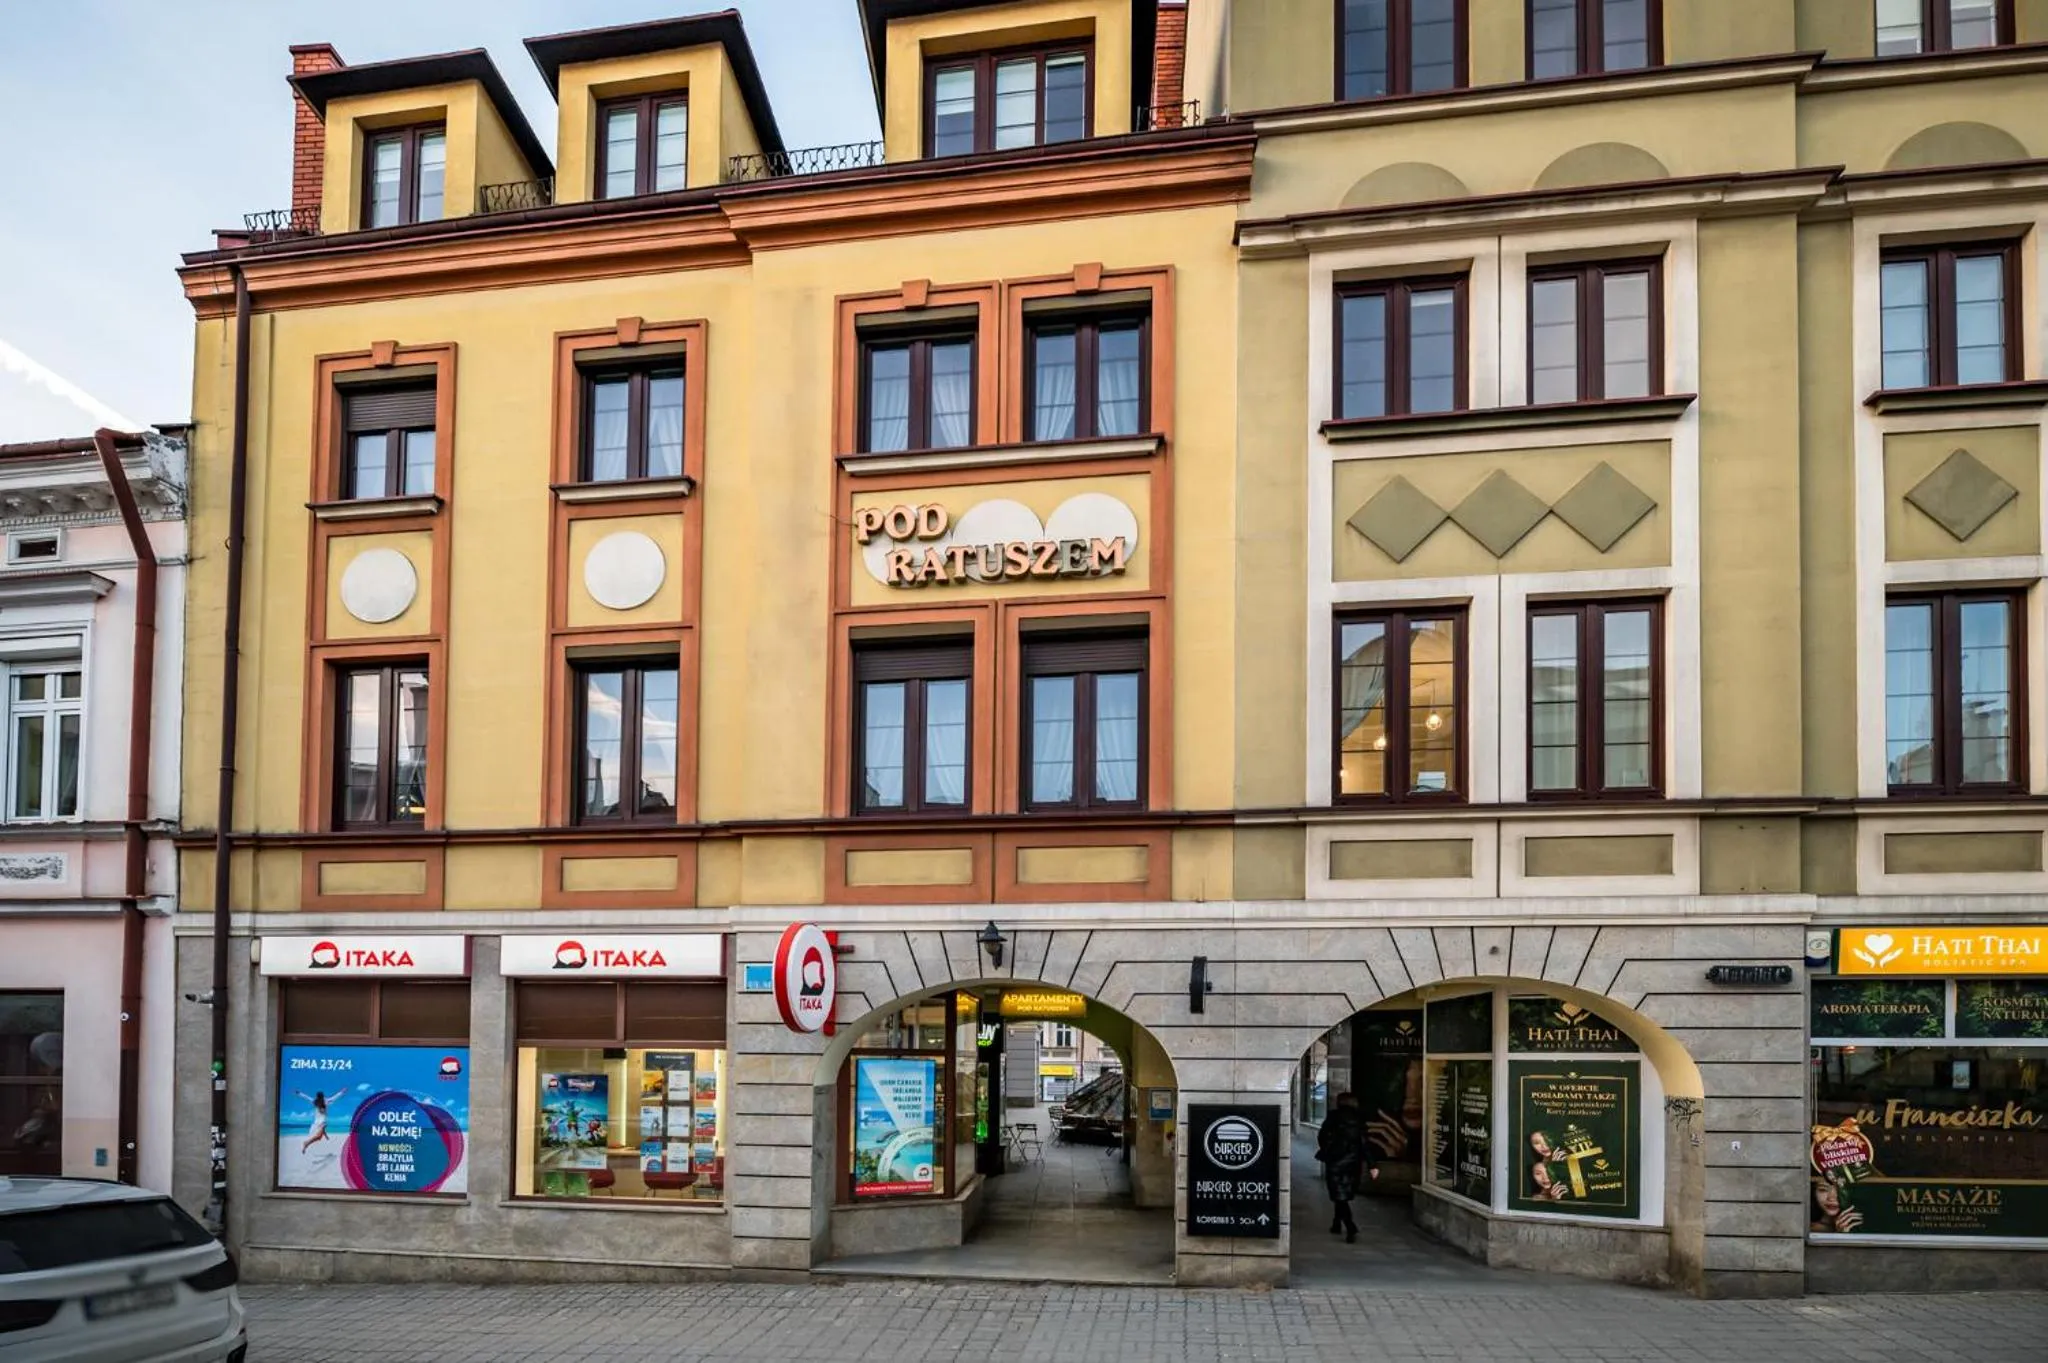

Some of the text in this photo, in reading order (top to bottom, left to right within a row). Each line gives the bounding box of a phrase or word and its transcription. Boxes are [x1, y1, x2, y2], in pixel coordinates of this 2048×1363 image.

[856, 503, 949, 545] POD
[885, 536, 1126, 586] RATUSZEM
[1912, 936, 2041, 955] HATI THAI
[345, 950, 414, 967] ITAKA
[593, 950, 667, 967] ITAKA
[1924, 958, 1994, 967] HOLISTIC
[800, 998, 823, 1010] ITAKA
[1003, 993, 1083, 1005] APARTAMENTY
[1983, 997, 2048, 1007] KOSMETY
[1820, 1003, 1931, 1014] AROMATERAPIA
[1983, 1009, 2048, 1020] NATURAL
[1528, 1027, 1618, 1041] HATI THAI
[290, 1059, 352, 1071] ZIMA 23/24
[1559, 1084, 1599, 1092] OFERCIE
[1531, 1092, 1584, 1100] POSIADAMY
[378, 1111, 416, 1123] ODLEĆ
[1857, 1099, 2043, 1130] u Franciszka
[372, 1126, 422, 1140] NA ZIMĘ!
[1214, 1142, 1253, 1155] BURGER
[378, 1153, 414, 1163] BRAZYLIA
[1821, 1153, 1867, 1169] VOUCHER
[390, 1163, 415, 1173] LANKA
[384, 1173, 407, 1182] KENIA
[1196, 1181, 1271, 1194] BURGER STORE
[1896, 1186, 2003, 1206] MASAŻE
